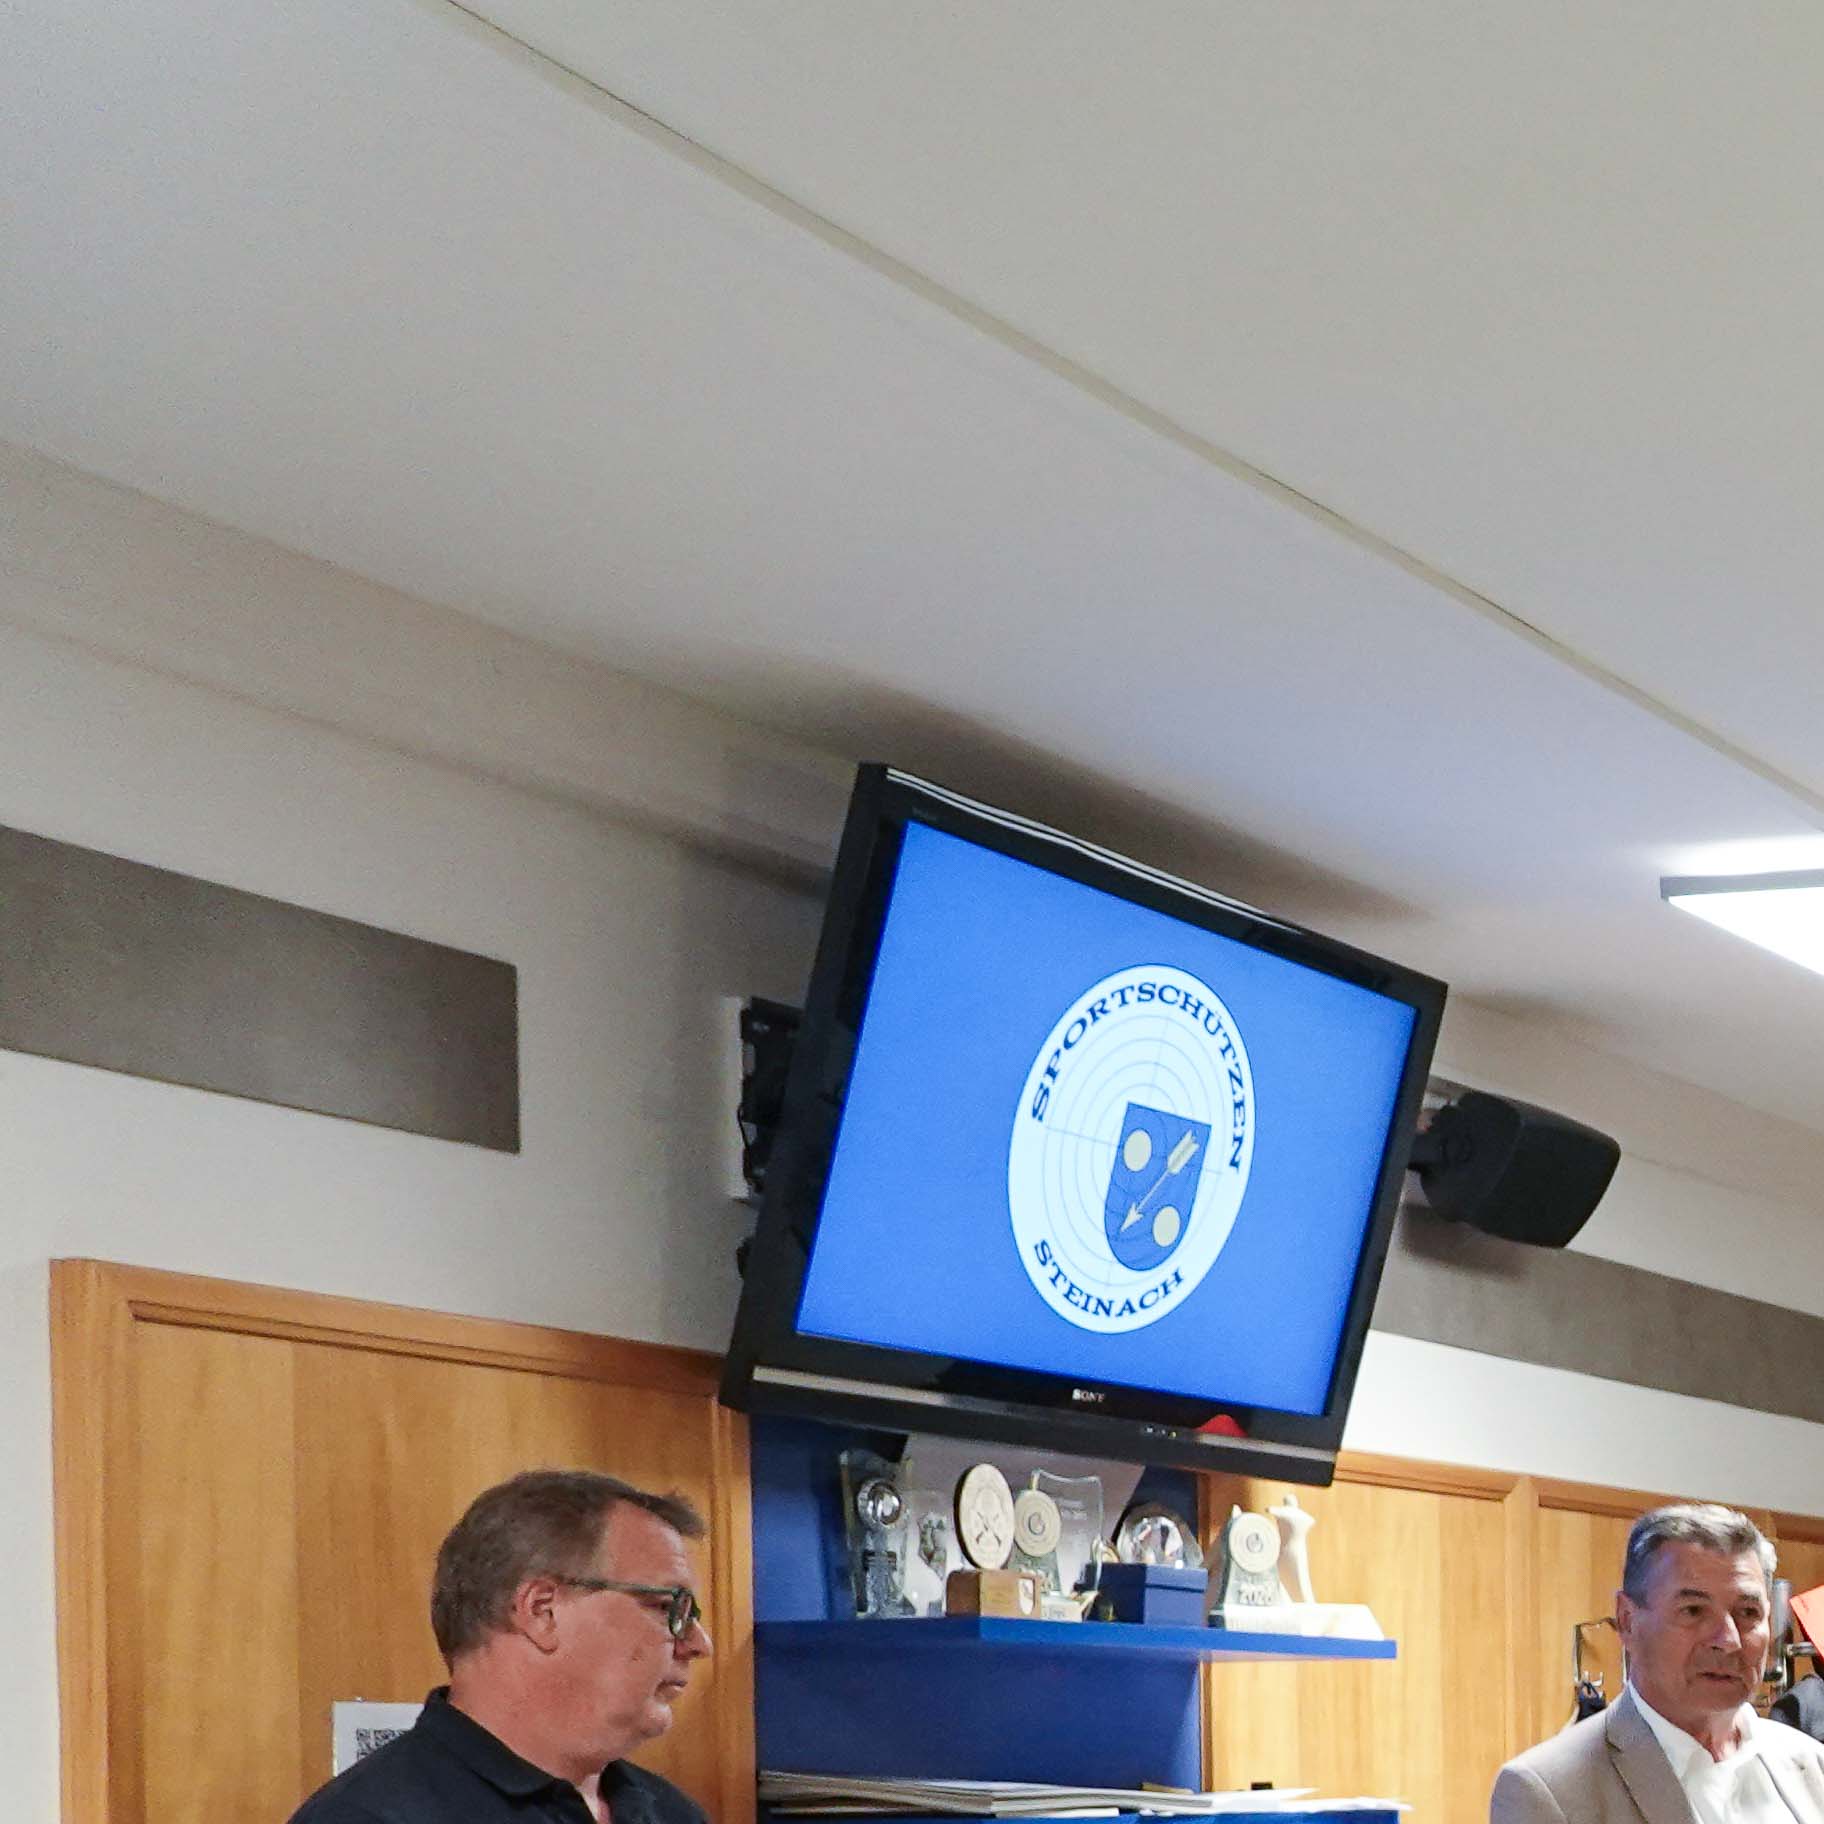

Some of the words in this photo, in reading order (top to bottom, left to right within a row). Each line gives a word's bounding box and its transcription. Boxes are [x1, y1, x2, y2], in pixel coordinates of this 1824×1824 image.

[1031, 982, 1247, 1171] SPORTSCHÜTZEN
[1033, 1238, 1185, 1318] STEINACH
[1072, 1388, 1105, 1402] SONY
